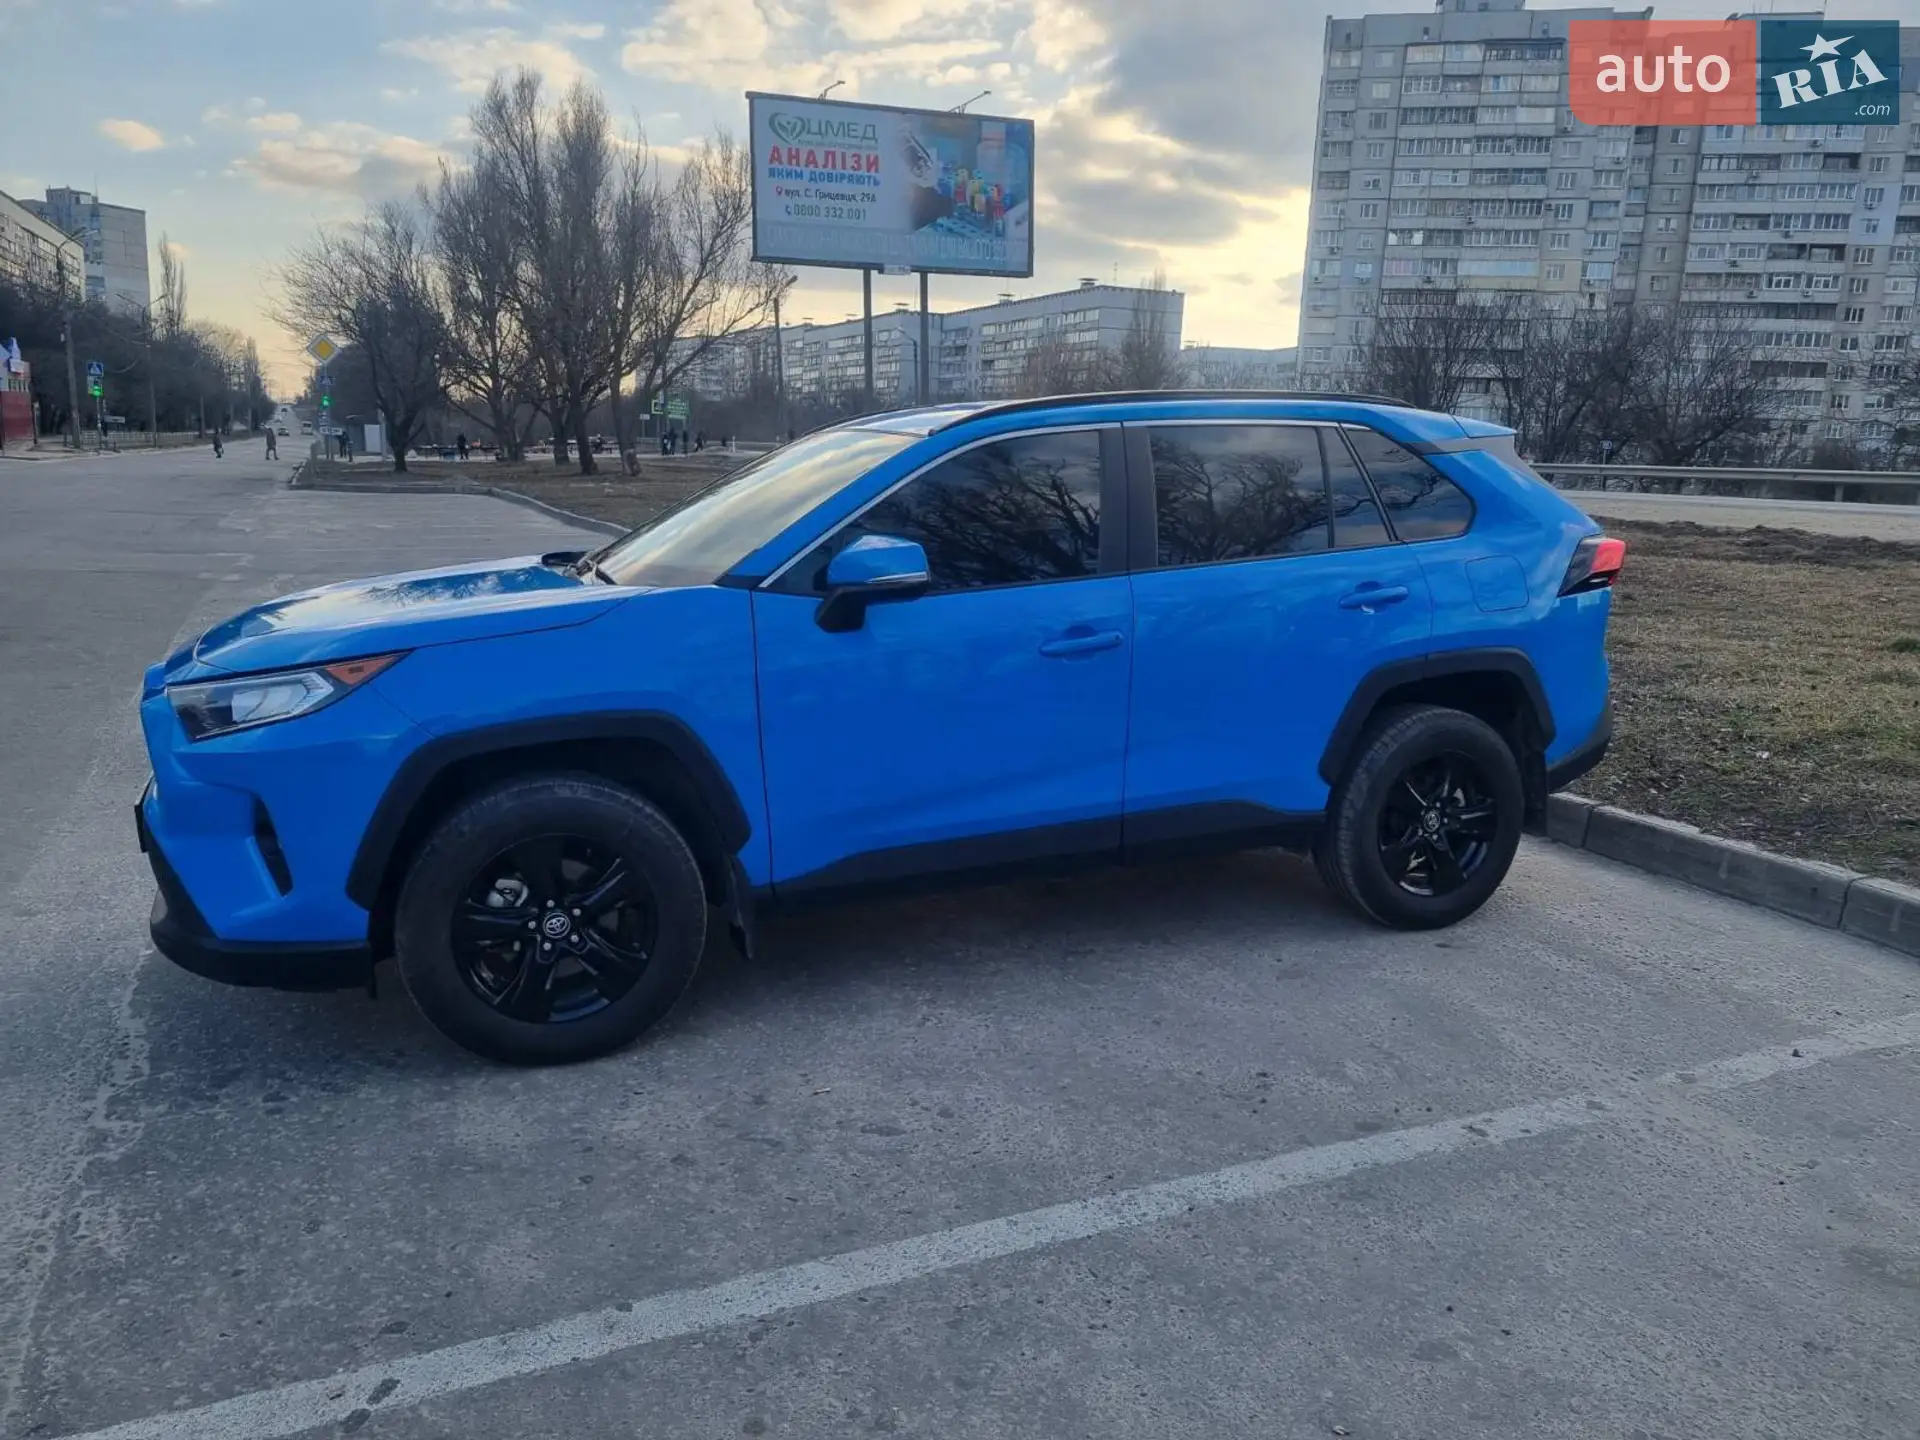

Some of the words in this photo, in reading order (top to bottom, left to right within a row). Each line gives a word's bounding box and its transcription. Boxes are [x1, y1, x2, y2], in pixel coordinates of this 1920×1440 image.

[768, 145, 880, 174] АНАЛІЗИ
[768, 167, 804, 181] ЯКИМ
[808, 171, 881, 187] ДОВІРЯЮТЬ
[793, 203, 821, 218] 0800
[824, 206, 844, 219] 332
[847, 208, 867, 221] 001
